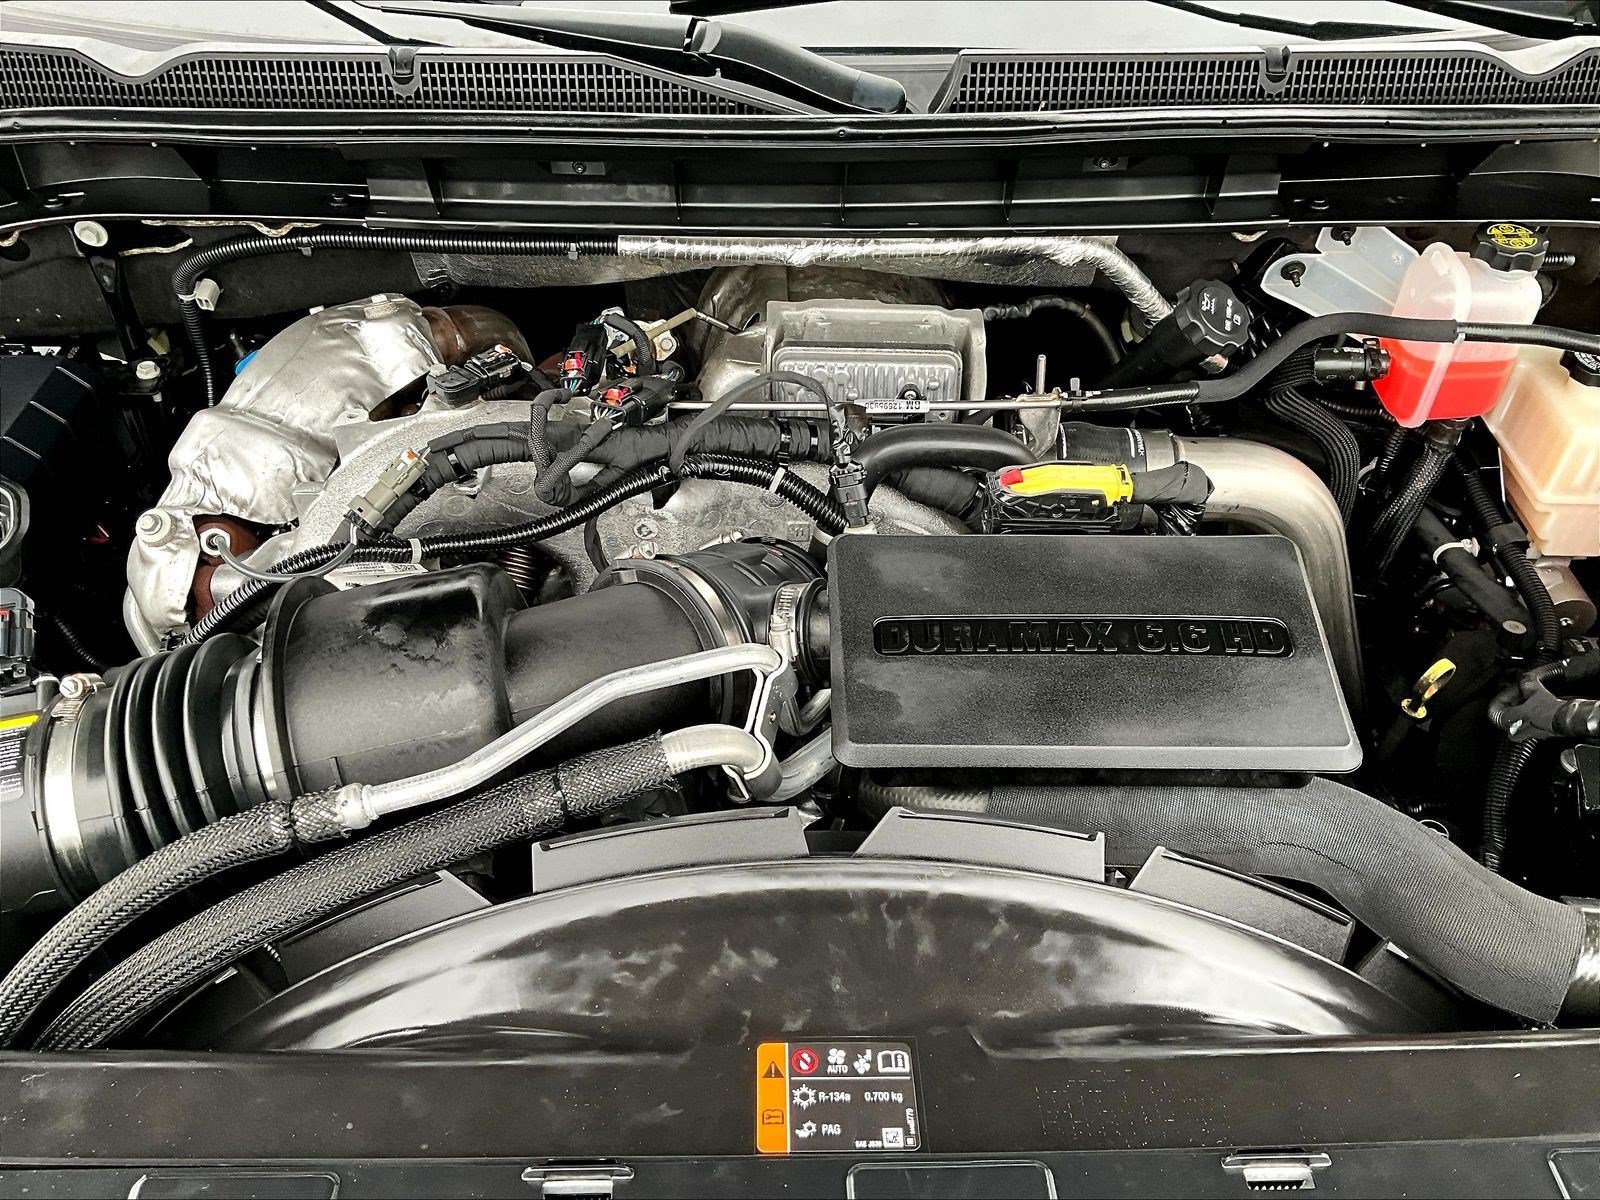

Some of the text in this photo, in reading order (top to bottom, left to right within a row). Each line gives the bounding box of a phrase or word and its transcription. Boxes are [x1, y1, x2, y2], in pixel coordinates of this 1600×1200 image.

[906, 400, 920, 410] GM
[881, 621, 1285, 654] DURAMAX 6.6 HD
[827, 1064, 848, 1074] AUTO
[818, 1090, 903, 1104] R-134a 0.700 kg
[821, 1123, 841, 1136] PAG
